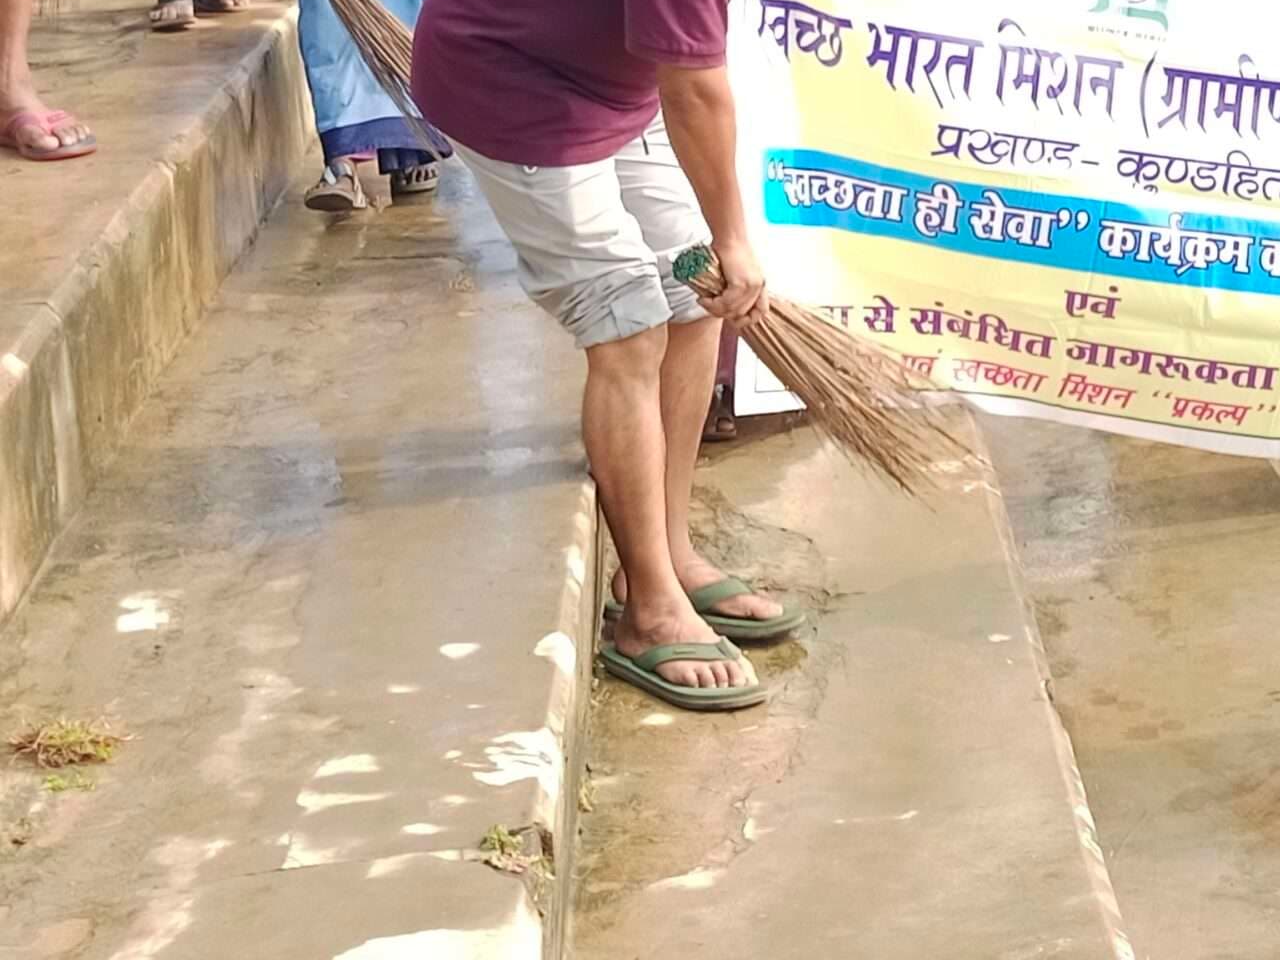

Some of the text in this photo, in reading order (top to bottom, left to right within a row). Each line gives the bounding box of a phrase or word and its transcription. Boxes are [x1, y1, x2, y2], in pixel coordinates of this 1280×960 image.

[865, 21, 984, 109] भारत
[995, 17, 1125, 123] मिशन
[913, 181, 963, 238] ही
[1098, 211, 1255, 277] कार्यक्रम
[862, 293, 900, 334] से
[909, 300, 1058, 359] संबंधित
[1065, 338, 1280, 392] जागरूकता
[1064, 285, 1122, 320] एवं
[952, 357, 1050, 394] स्वच्छता
[1057, 372, 1136, 409] मिशन
